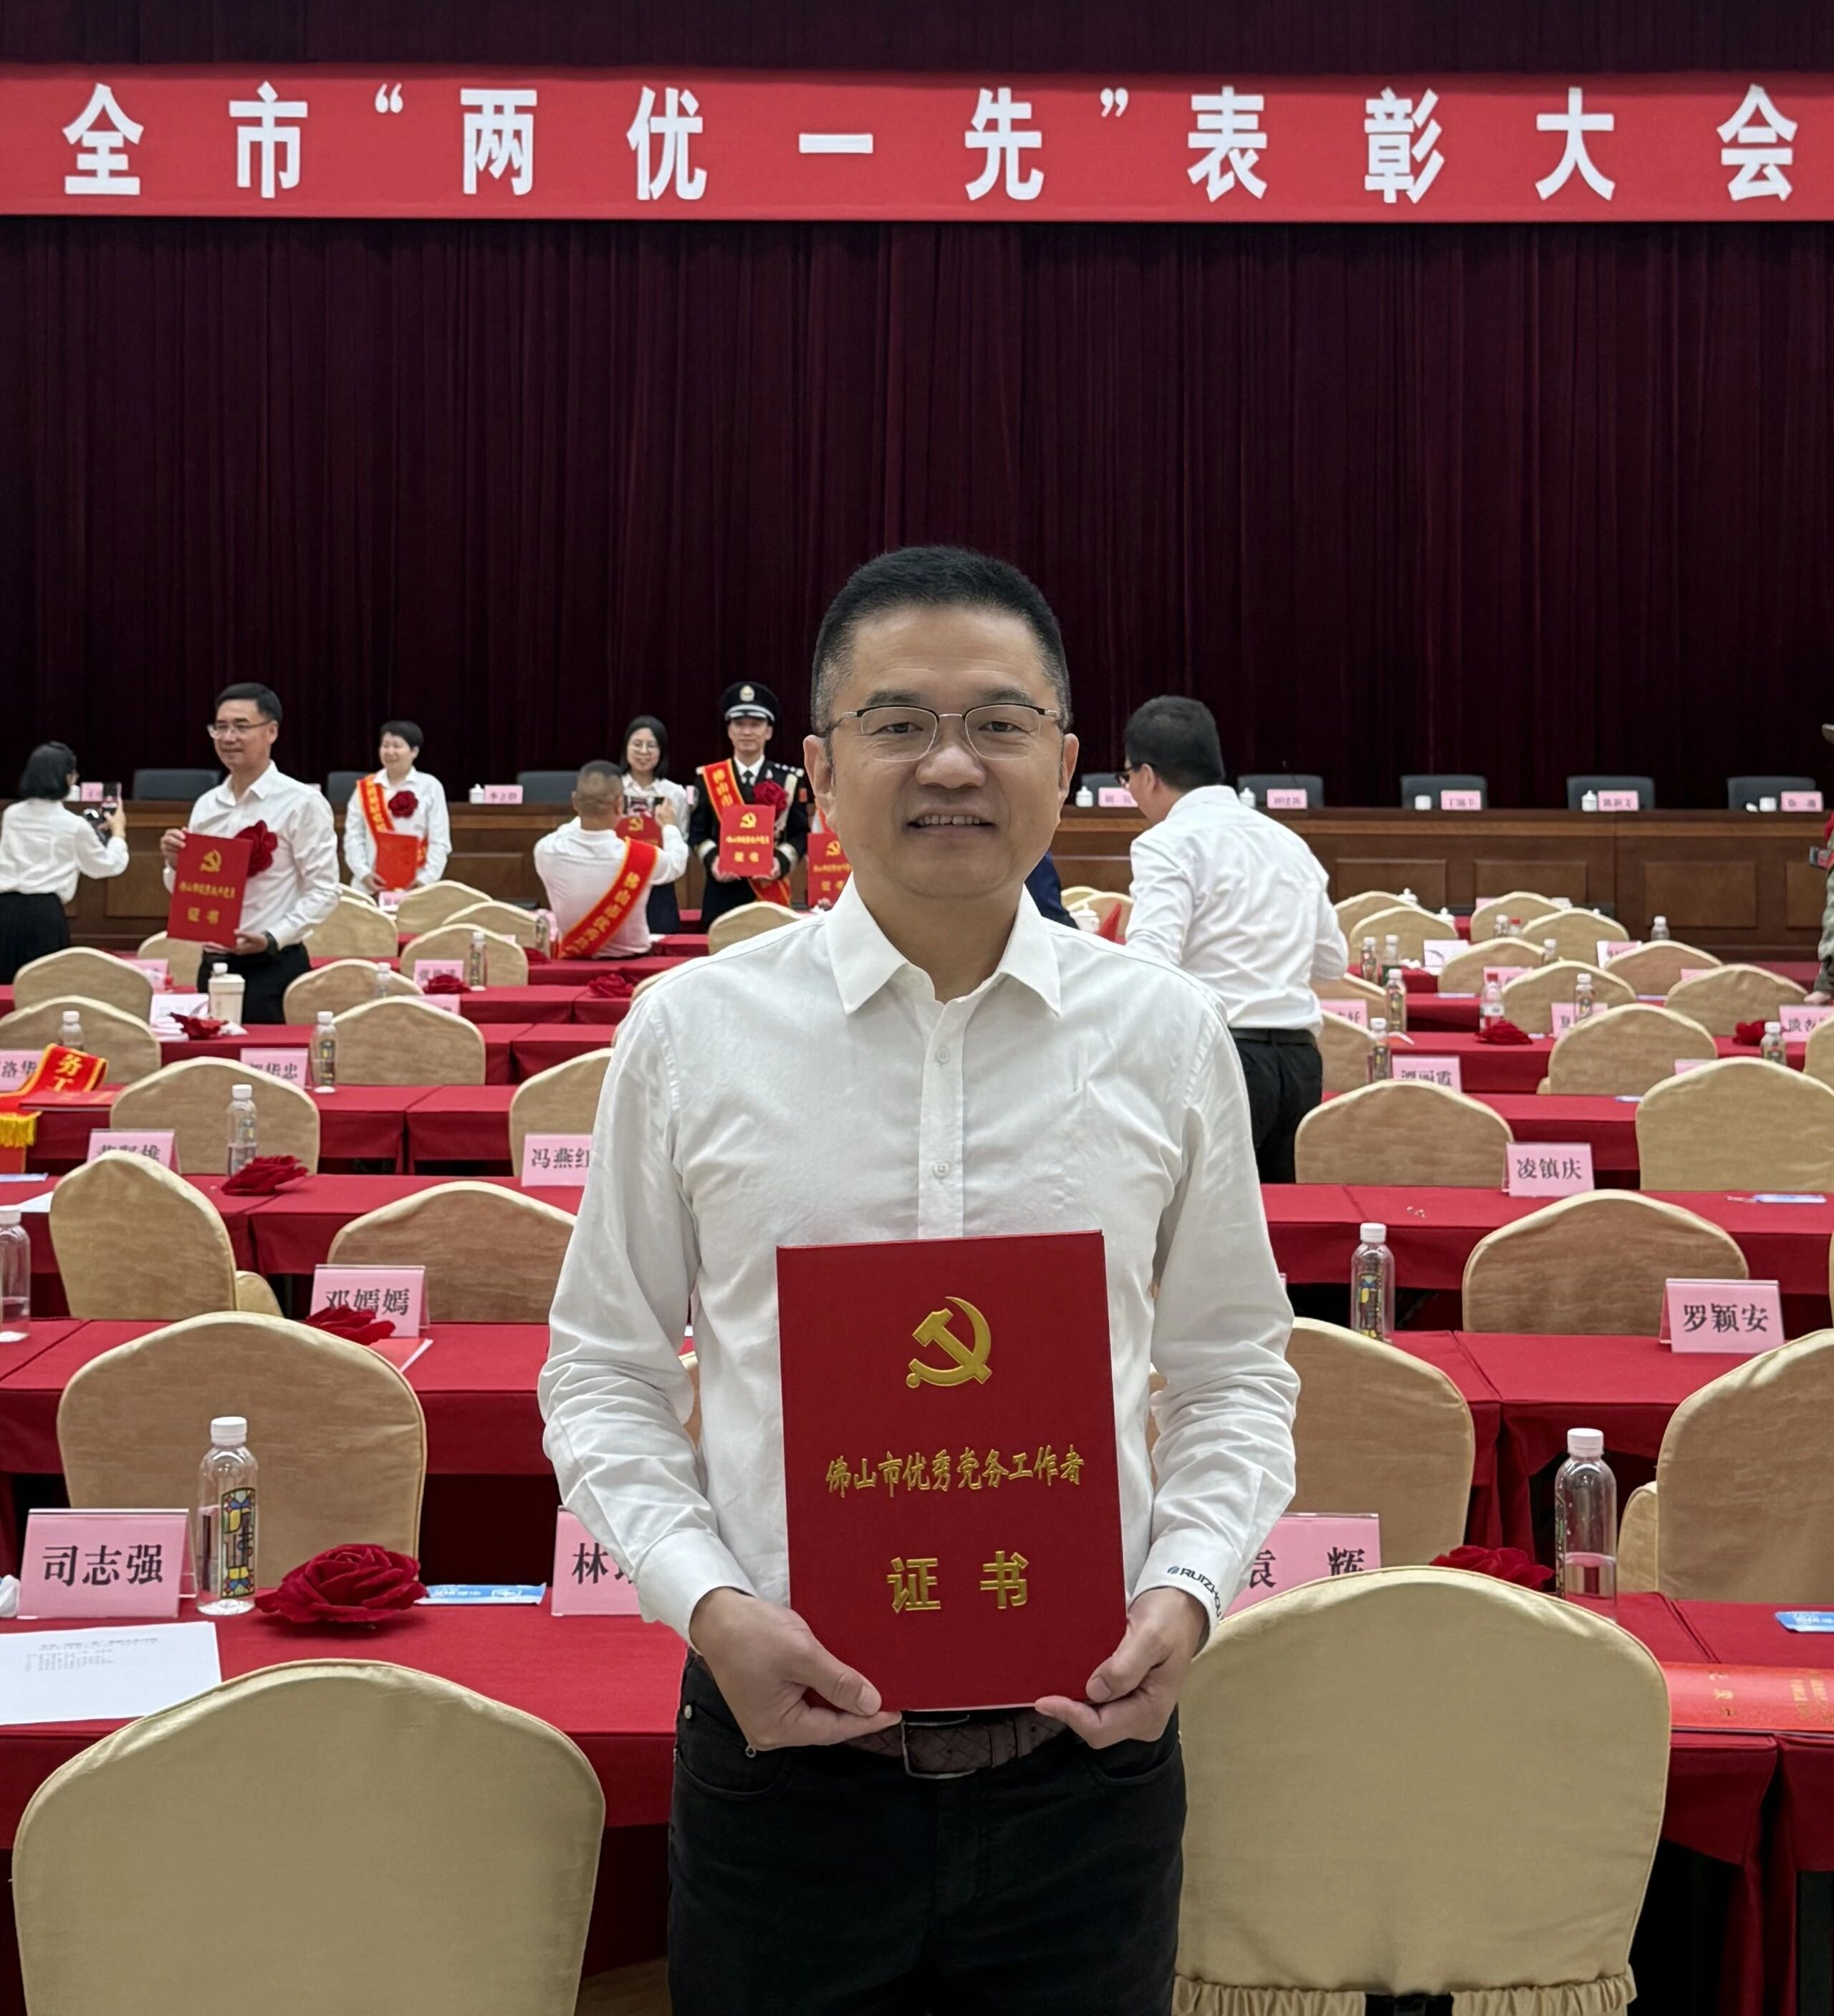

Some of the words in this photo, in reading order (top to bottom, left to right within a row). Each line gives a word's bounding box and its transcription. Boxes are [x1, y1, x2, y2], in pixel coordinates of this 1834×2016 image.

[1517, 1158, 1583, 1180] 凌镇庆
[1683, 1302, 1770, 1333] 罗颖安
[825, 1444, 1085, 1499] 佛山市优秀党务工作者
[42, 1544, 164, 1588] 司志强
[571, 1542, 633, 1585] 林
[887, 1550, 1030, 1614] 证书
